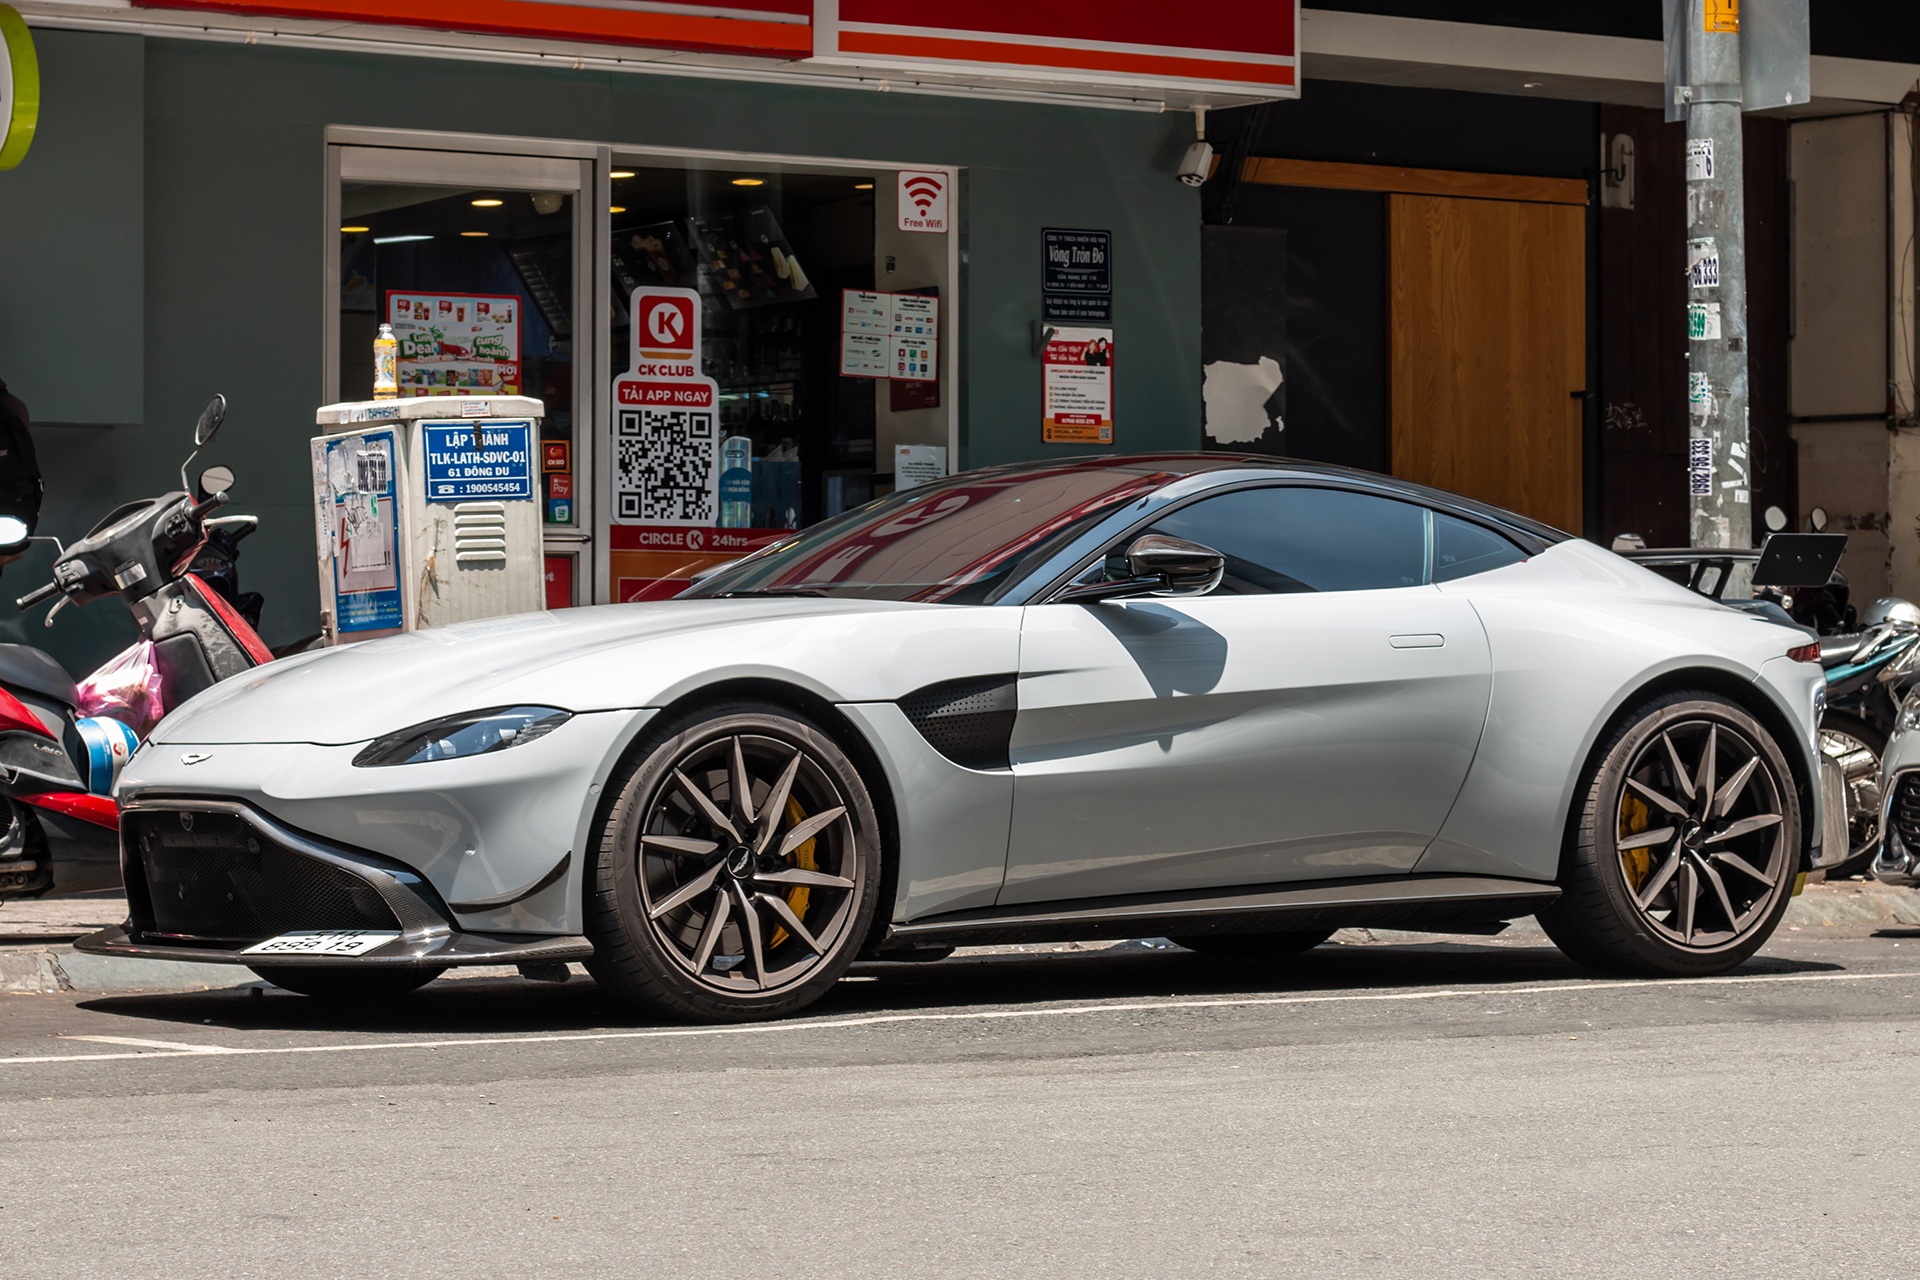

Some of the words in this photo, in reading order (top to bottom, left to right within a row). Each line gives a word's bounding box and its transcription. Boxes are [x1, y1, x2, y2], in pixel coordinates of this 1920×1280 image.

[904, 218, 923, 228] Free
[926, 219, 942, 228] Wifi
[1049, 245, 1070, 268] Vòng
[1072, 246, 1090, 263] Tròn
[1092, 245, 1104, 264] Đỏ
[476, 335, 503, 345] tung
[479, 346, 509, 357] hoành
[638, 364, 657, 376] CK
[659, 365, 694, 377] CLUB
[623, 385, 643, 400] TẢI
[646, 390, 671, 401] APP
[674, 391, 709, 403] NGAY
[446, 431, 468, 449] LẬP
[430, 451, 525, 465] TLK-LATH-SDVC-01
[448, 468, 461, 477] 61
[464, 466, 492, 476] ĐÔNG
[495, 467, 509, 476] DU
[1692, 440, 1710, 494] 0982.756.333
[466, 483, 520, 493] 1900545454
[553, 483, 568, 494] Pay
[639, 532, 683, 546] CIRCLE
[686, 530, 704, 549] K
[712, 535, 748, 546] 24hrs
